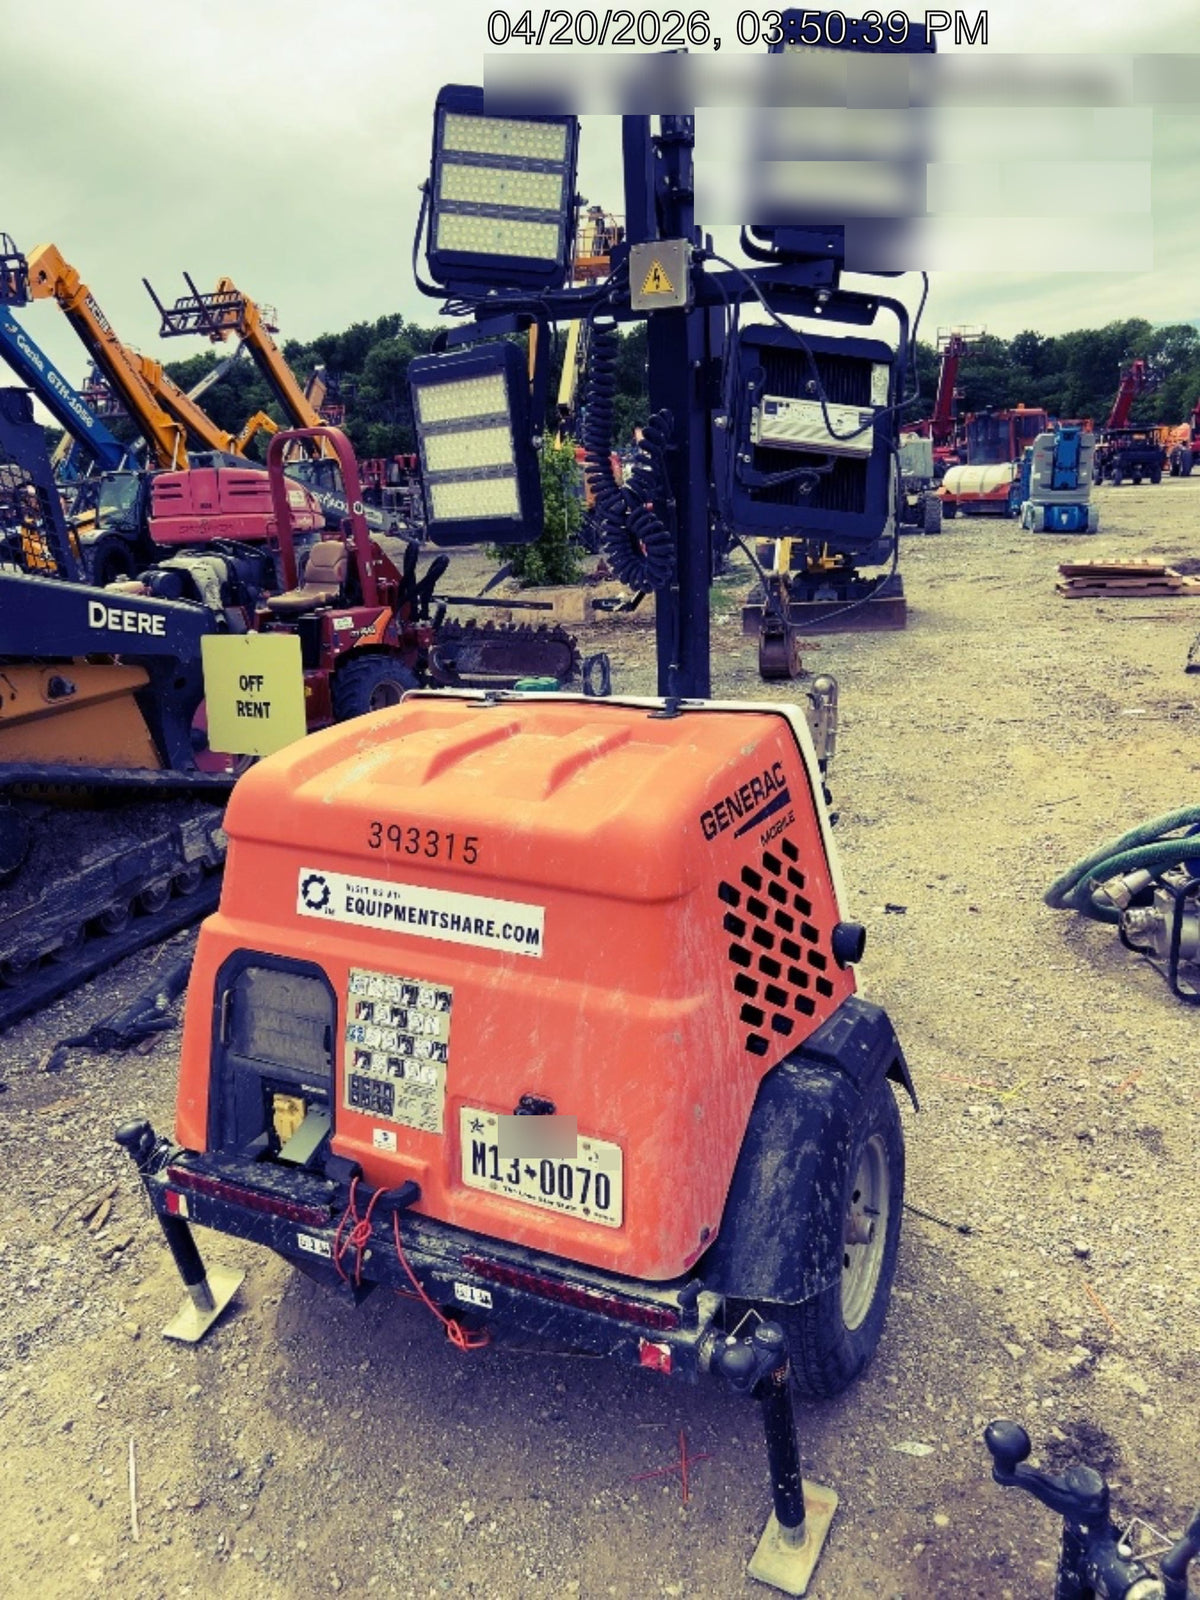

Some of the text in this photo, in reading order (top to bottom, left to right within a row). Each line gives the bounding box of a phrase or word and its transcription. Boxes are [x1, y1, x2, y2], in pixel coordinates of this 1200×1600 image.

[88, 600, 166, 636] DEERE
[239, 675, 264, 692] OFF
[236, 700, 271, 719] RENT
[700, 761, 787, 841] GENERAC
[367, 821, 479, 865] 393315
[760, 810, 796, 847] MOBILE
[345, 896, 540, 946] EQUIPMENTSHARE.COM
